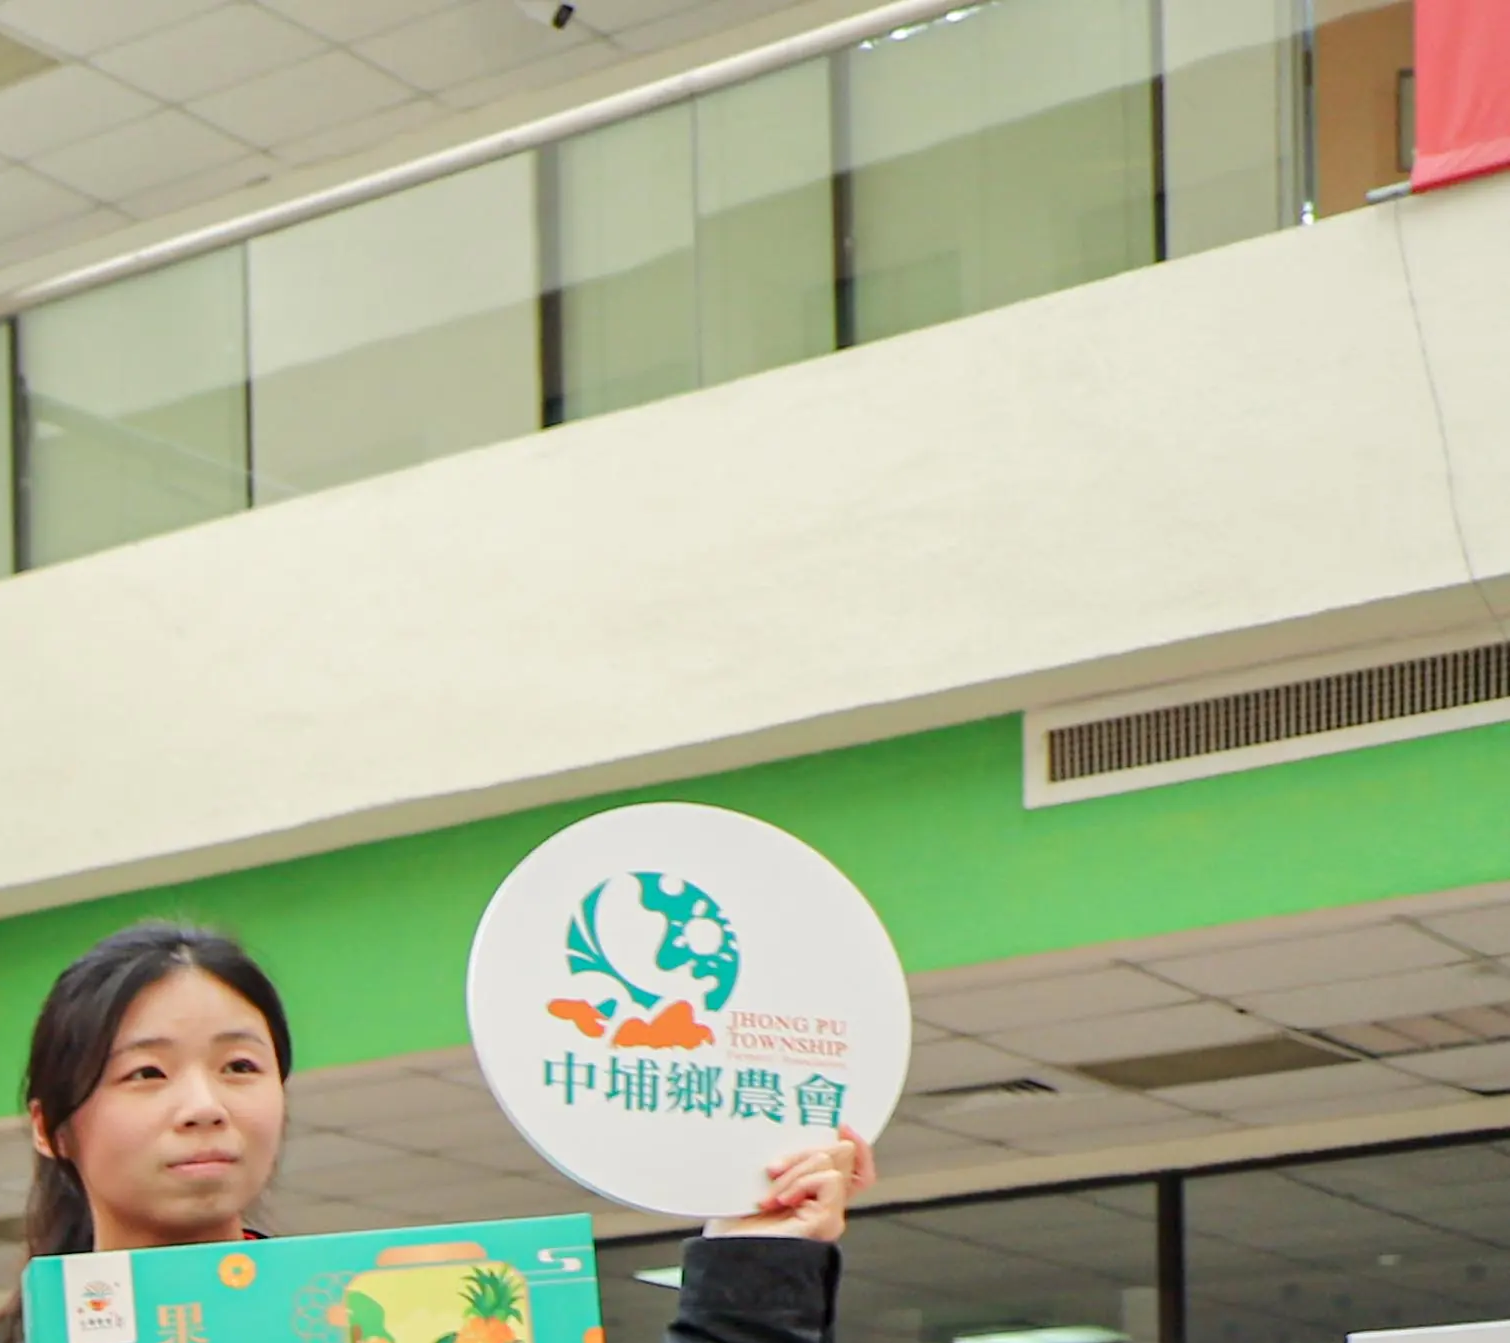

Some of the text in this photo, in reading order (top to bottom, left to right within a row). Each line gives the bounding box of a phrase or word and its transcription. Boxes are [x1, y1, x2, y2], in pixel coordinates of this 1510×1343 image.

[727, 1010, 847, 1036] JHONG PU
[728, 1032, 849, 1057] TOWNSHIP
[543, 1050, 848, 1130] 中埔鄉農會
